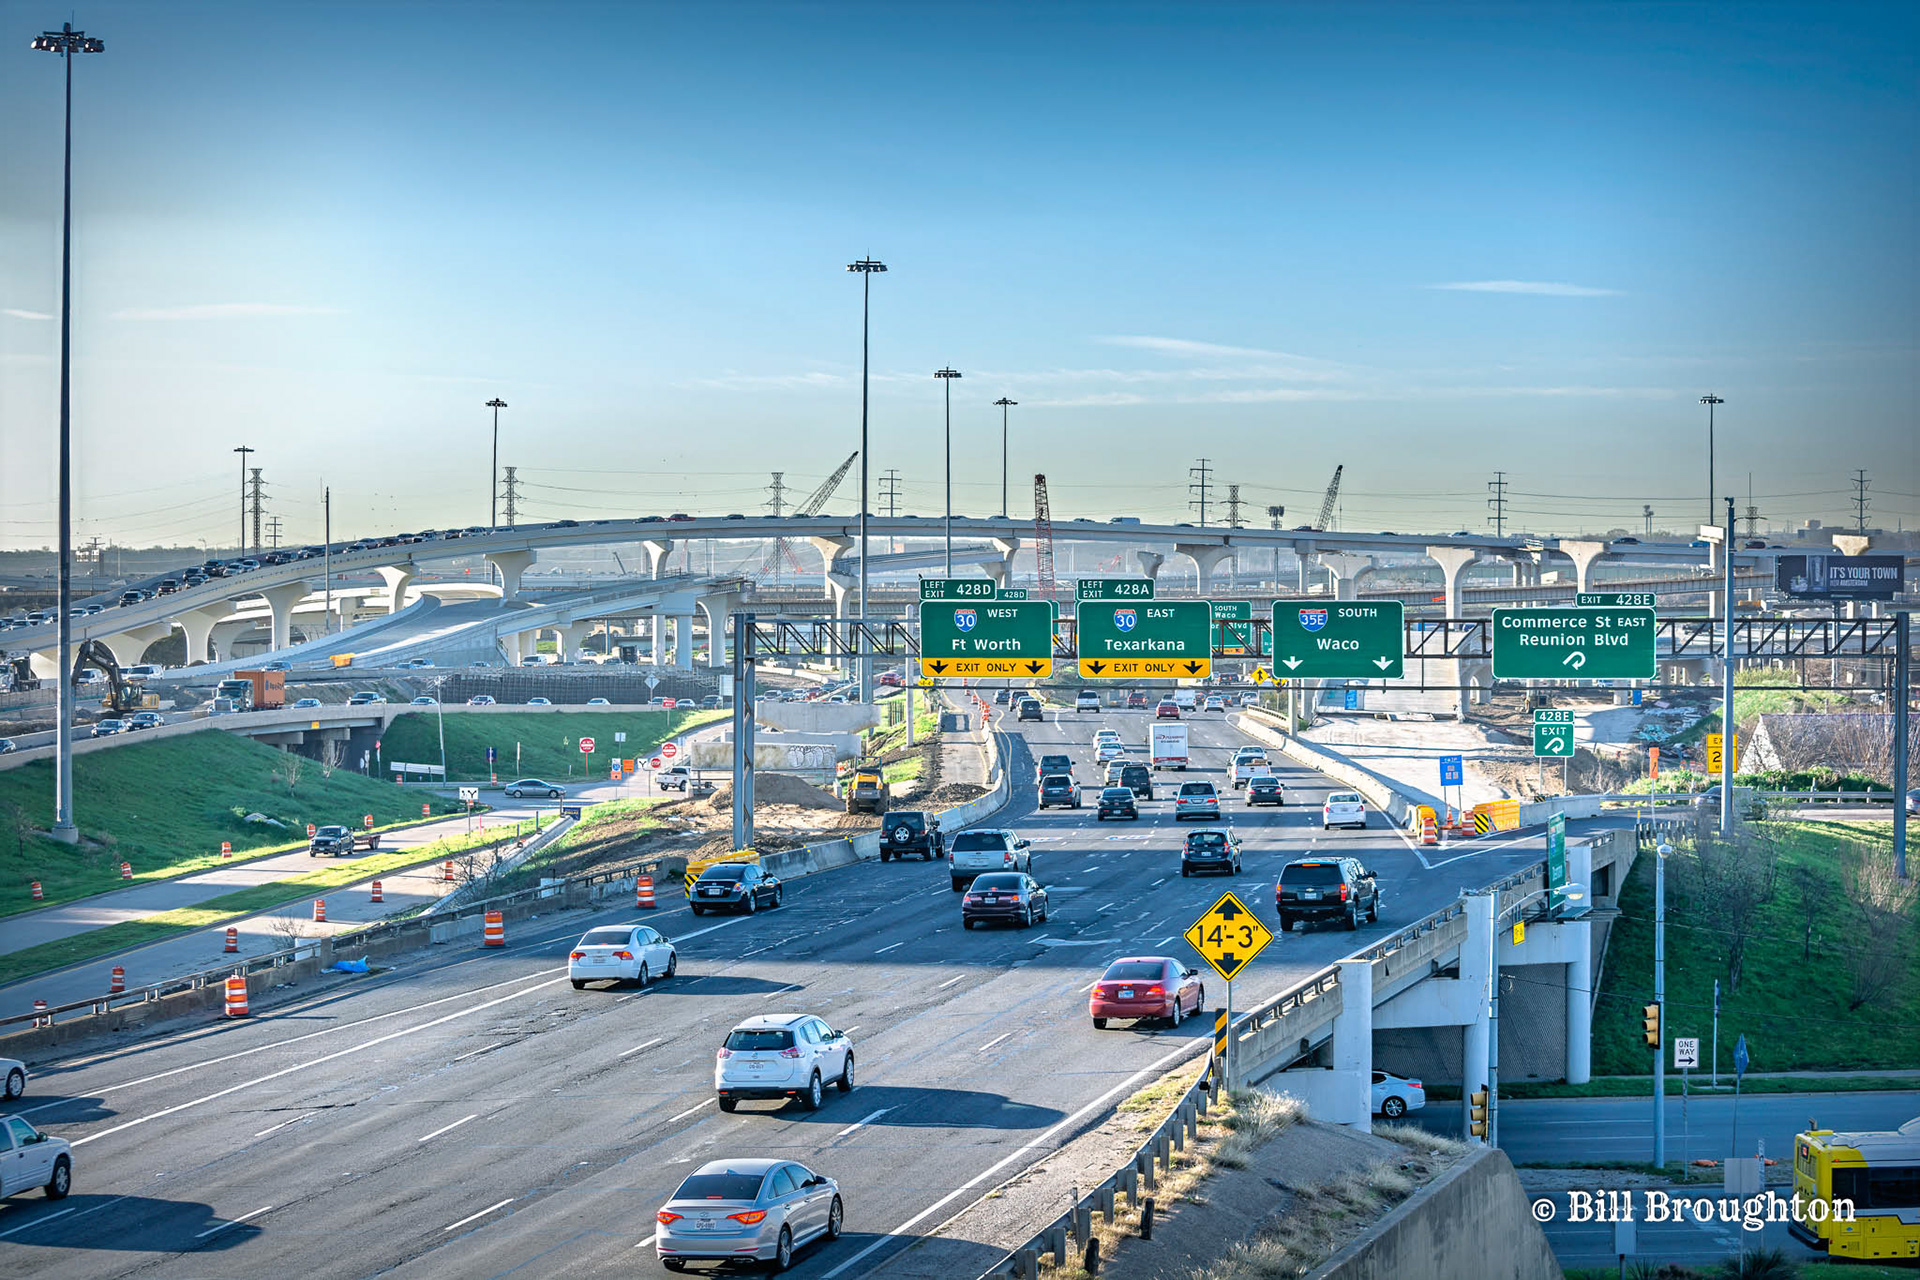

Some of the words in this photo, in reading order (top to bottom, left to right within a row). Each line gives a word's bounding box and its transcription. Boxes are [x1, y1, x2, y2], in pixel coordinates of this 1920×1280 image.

[1830, 567, 1846, 579] IT'S
[1848, 567, 1870, 579] YOUR
[1872, 567, 1898, 579] TOWN
[956, 584, 991, 595] 428D
[1114, 584, 1149, 595] 428A
[1616, 594, 1650, 606] 428E
[987, 609, 1018, 618] WEST
[1147, 609, 1175, 618] EAST
[1302, 615, 1324, 625] 35E
[1338, 608, 1377, 617] SOUTH
[957, 615, 974, 627] 30
[1117, 615, 1135, 627] 30
[1502, 617, 1587, 628] Commerce
[1595, 617, 1611, 628] St
[1618, 617, 1647, 626] EAST
[952, 639, 966, 650] Ft
[974, 639, 1021, 650] Worth
[1105, 639, 1185, 650] Texarkana
[1317, 639, 1359, 650] Waco
[1520, 633, 1585, 646] Reunion
[1595, 633, 1628, 646] Blvd
[957, 664, 980, 672] EXIT
[987, 664, 1016, 672] ONLY
[1114, 664, 1138, 672] EXIT
[1145, 664, 1175, 672] ONLY
[1539, 712, 1569, 721] 428E
[1197, 925, 1258, 948] 14'-3"
